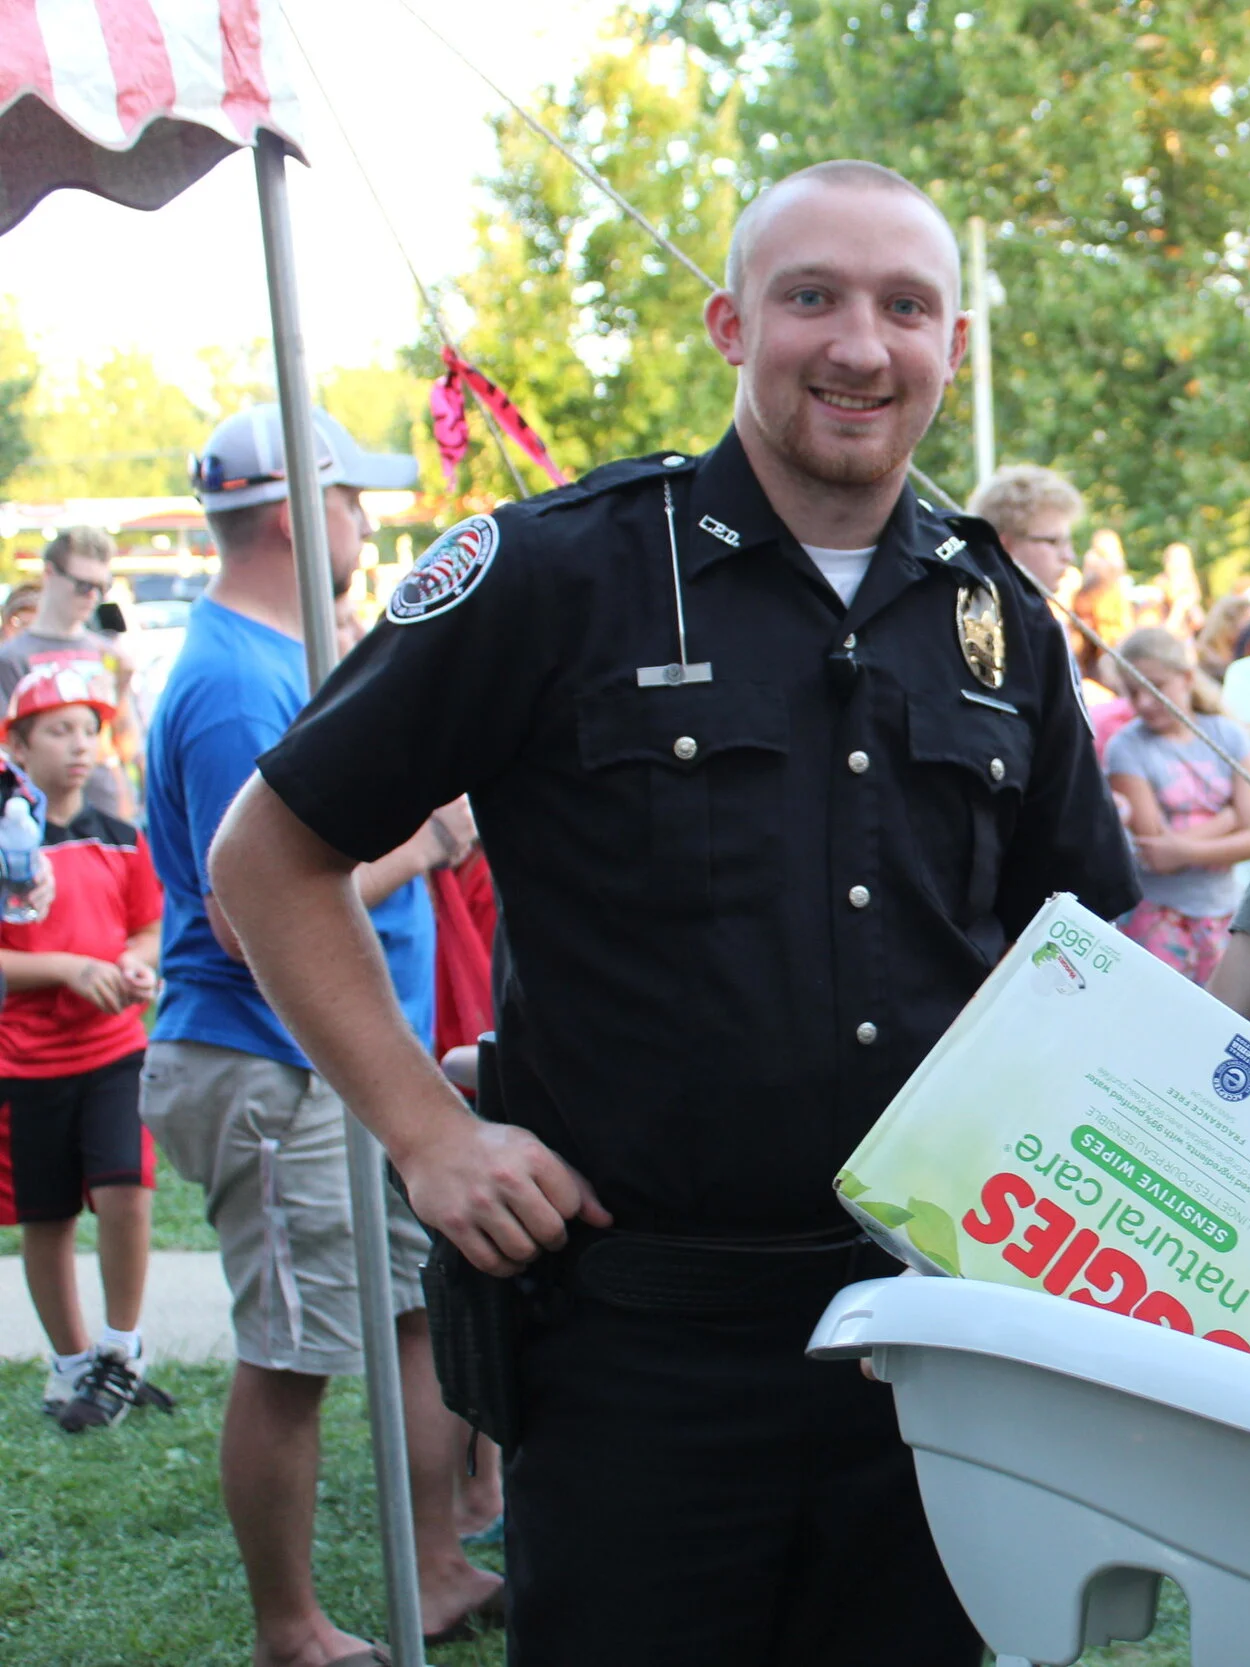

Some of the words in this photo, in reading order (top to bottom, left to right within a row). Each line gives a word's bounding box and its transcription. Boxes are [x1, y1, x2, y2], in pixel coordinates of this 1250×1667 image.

[1049, 920, 1092, 957] 560
[1093, 953, 1112, 974] 10
[1083, 1071, 1110, 1093] water
[1166, 1086, 1190, 1106] FREE
[1108, 1088, 1146, 1118] purified
[1083, 1104, 1137, 1146] SENSIBLE
[1143, 1114, 1164, 1132] 99%
[1162, 1127, 1184, 1146] with
[1190, 1103, 1246, 1145] FRAGRANCE
[1081, 1134, 1134, 1177] WIPES
[1134, 1140, 1165, 1166] PEAU
[1180, 1139, 1236, 1183] ingredients,
[1162, 1160, 1195, 1188] POUR
[1136, 1173, 1227, 1242] SENSITIVE
[1097, 1198, 1249, 1312] natural
